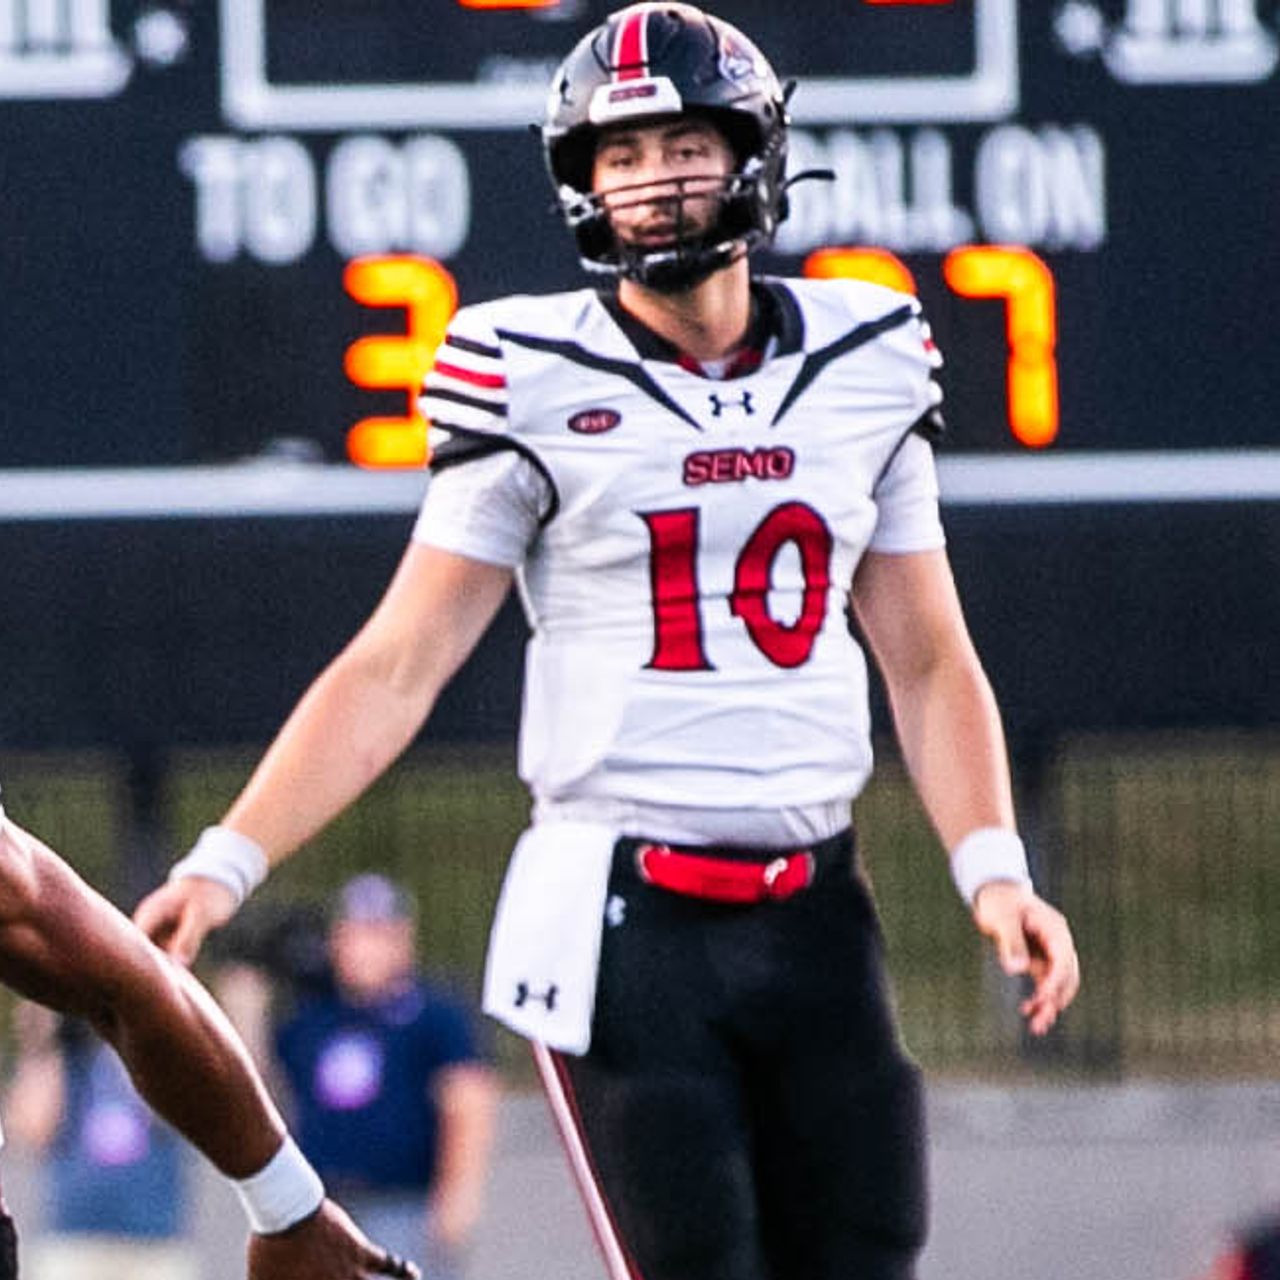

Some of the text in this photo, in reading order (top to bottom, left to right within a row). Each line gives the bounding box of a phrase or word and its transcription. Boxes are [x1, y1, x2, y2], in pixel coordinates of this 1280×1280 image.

[178, 134, 470, 265] TO GO
[975, 125, 1106, 252] ON
[343, 254, 458, 470] 3
[801, 243, 1058, 448] 7
[683, 446, 796, 487] SEMO
[632, 500, 835, 672] 10
